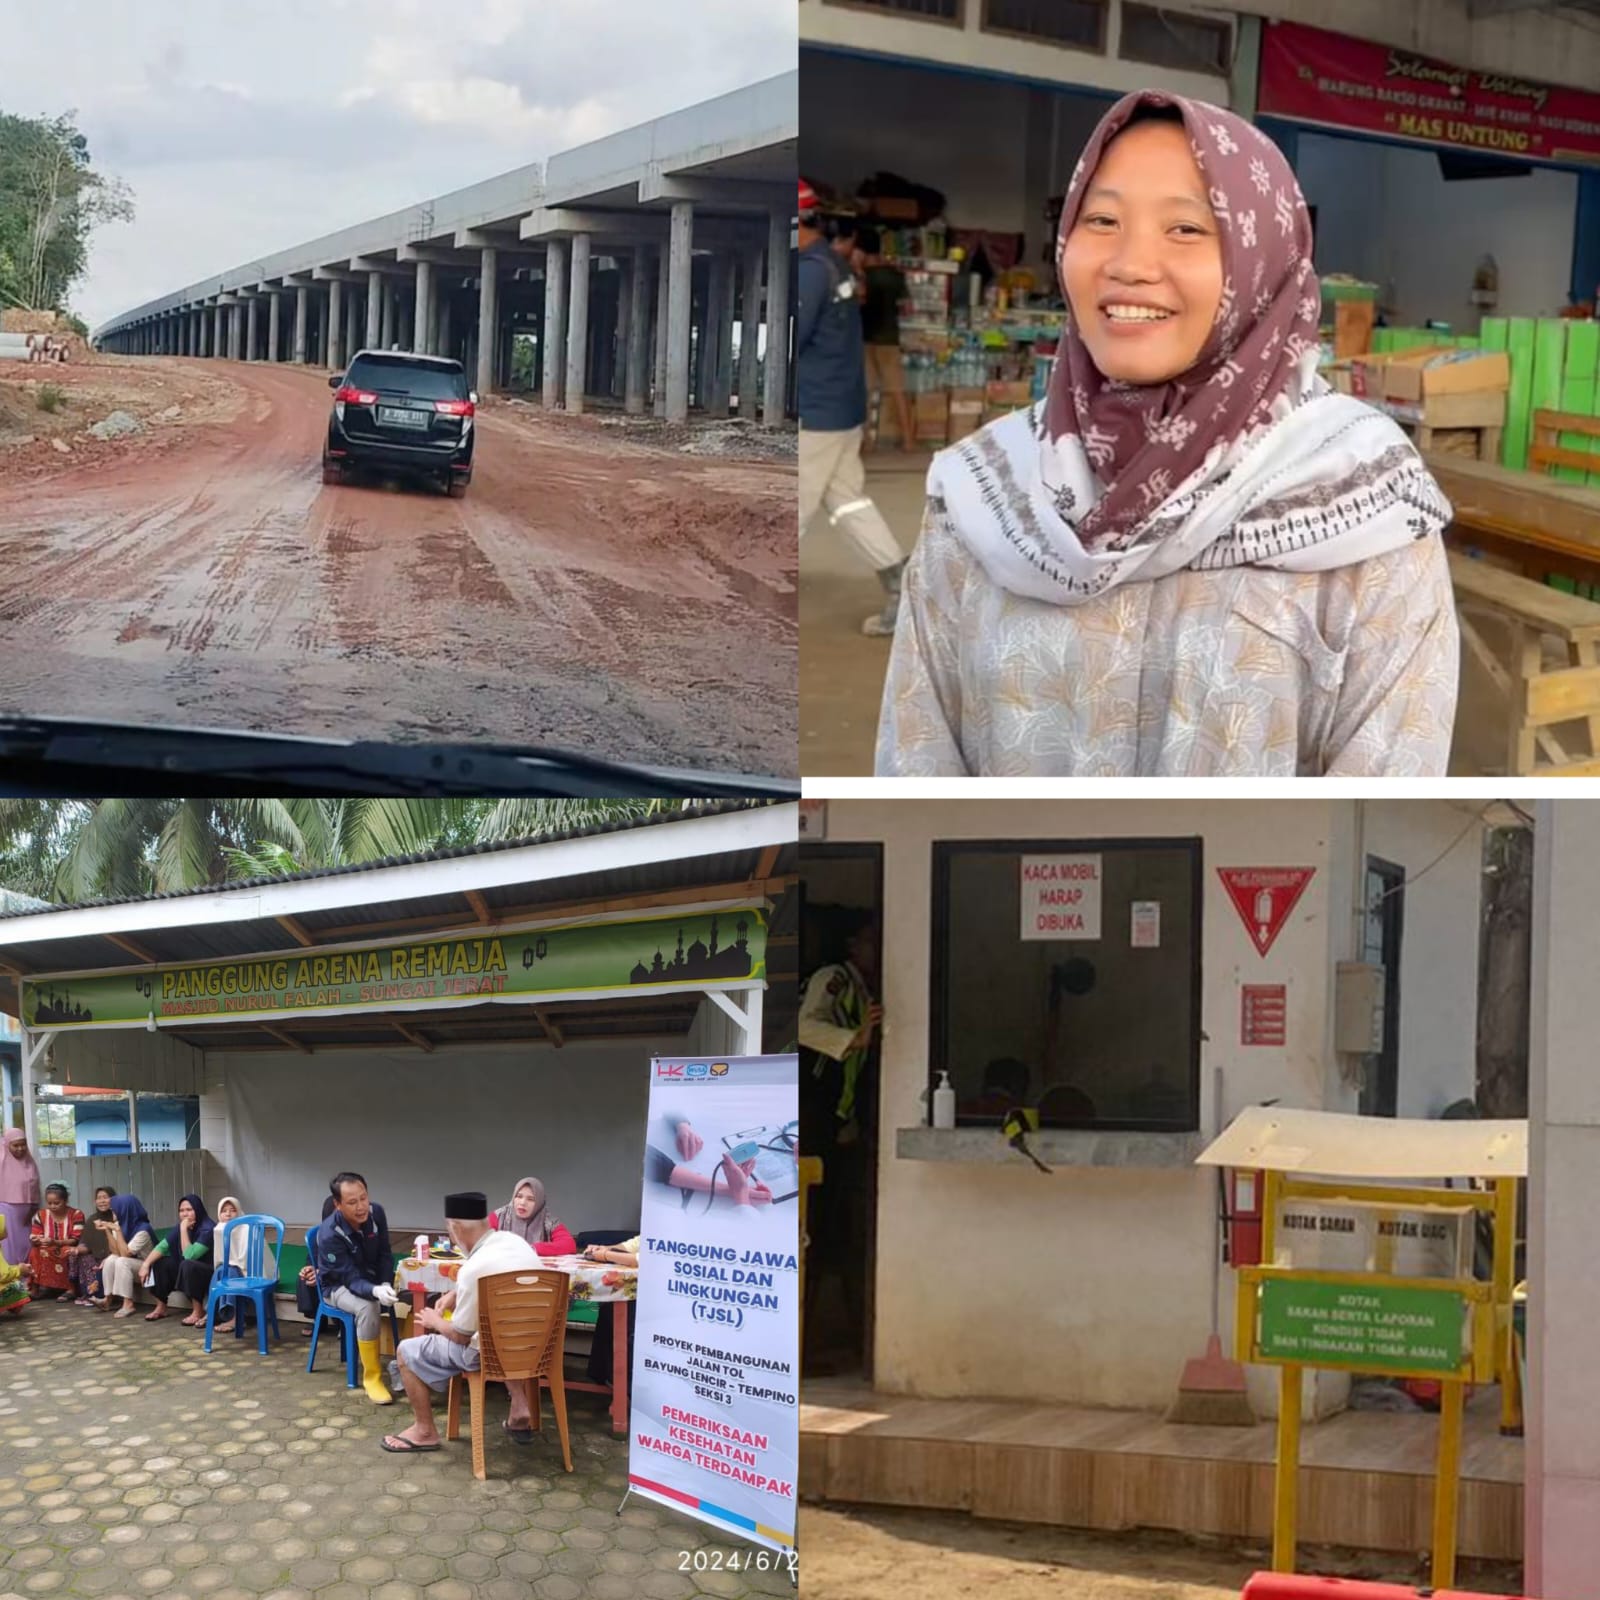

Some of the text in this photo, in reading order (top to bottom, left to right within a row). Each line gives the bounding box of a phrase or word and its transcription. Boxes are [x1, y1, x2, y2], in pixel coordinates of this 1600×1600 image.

[1399, 113, 1529, 150] MAS UNTUNG
[1024, 863, 1099, 880] KACA MOBIL
[1039, 888, 1083, 905] HARAP
[1037, 914, 1084, 931] DIBUKA
[162, 939, 507, 999] PANGGUNG ARENA REMAJA
[161, 998, 219, 1016] MASJID
[225, 995, 279, 1012] NURUL
[285, 990, 341, 1008] FALAH
[360, 980, 435, 1002] SUNGAI
[442, 975, 508, 998] JERAT
[1283, 1214, 1355, 1233] KOTAK SARAN
[1378, 1220, 1417, 1238] KOTAK
[646, 1238, 797, 1270] TANGGUNG JAWA
[674, 1261, 773, 1288] SOSIAL DAN
[667, 1279, 778, 1310] LINGKUNGAN
[1338, 1295, 1381, 1308] KOTAK
[691, 1300, 744, 1328] (TJSL)
[1287, 1306, 1434, 1327] SARAN SERTA LAPORAN
[1313, 1323, 1406, 1341] KONDISI TIDAK
[653, 1334, 791, 1374] PROYEK PEMBANGUNAN
[1273, 1335, 1447, 1359] DAN TINDAKAN TIDAK AMAN
[644, 1358, 689, 1378] BAYUNG
[690, 1371, 727, 1390] LENCIR
[738, 1384, 796, 1405] TEMPINO
[686, 1356, 745, 1380] JALAN TOL
[694, 1385, 733, 1405] SEKSI 3
[662, 1405, 768, 1449] PEMERIKSAAN
[669, 1425, 756, 1467] KESEHATAN
[637, 1433, 793, 1497] WARGA TERDAMPAK
